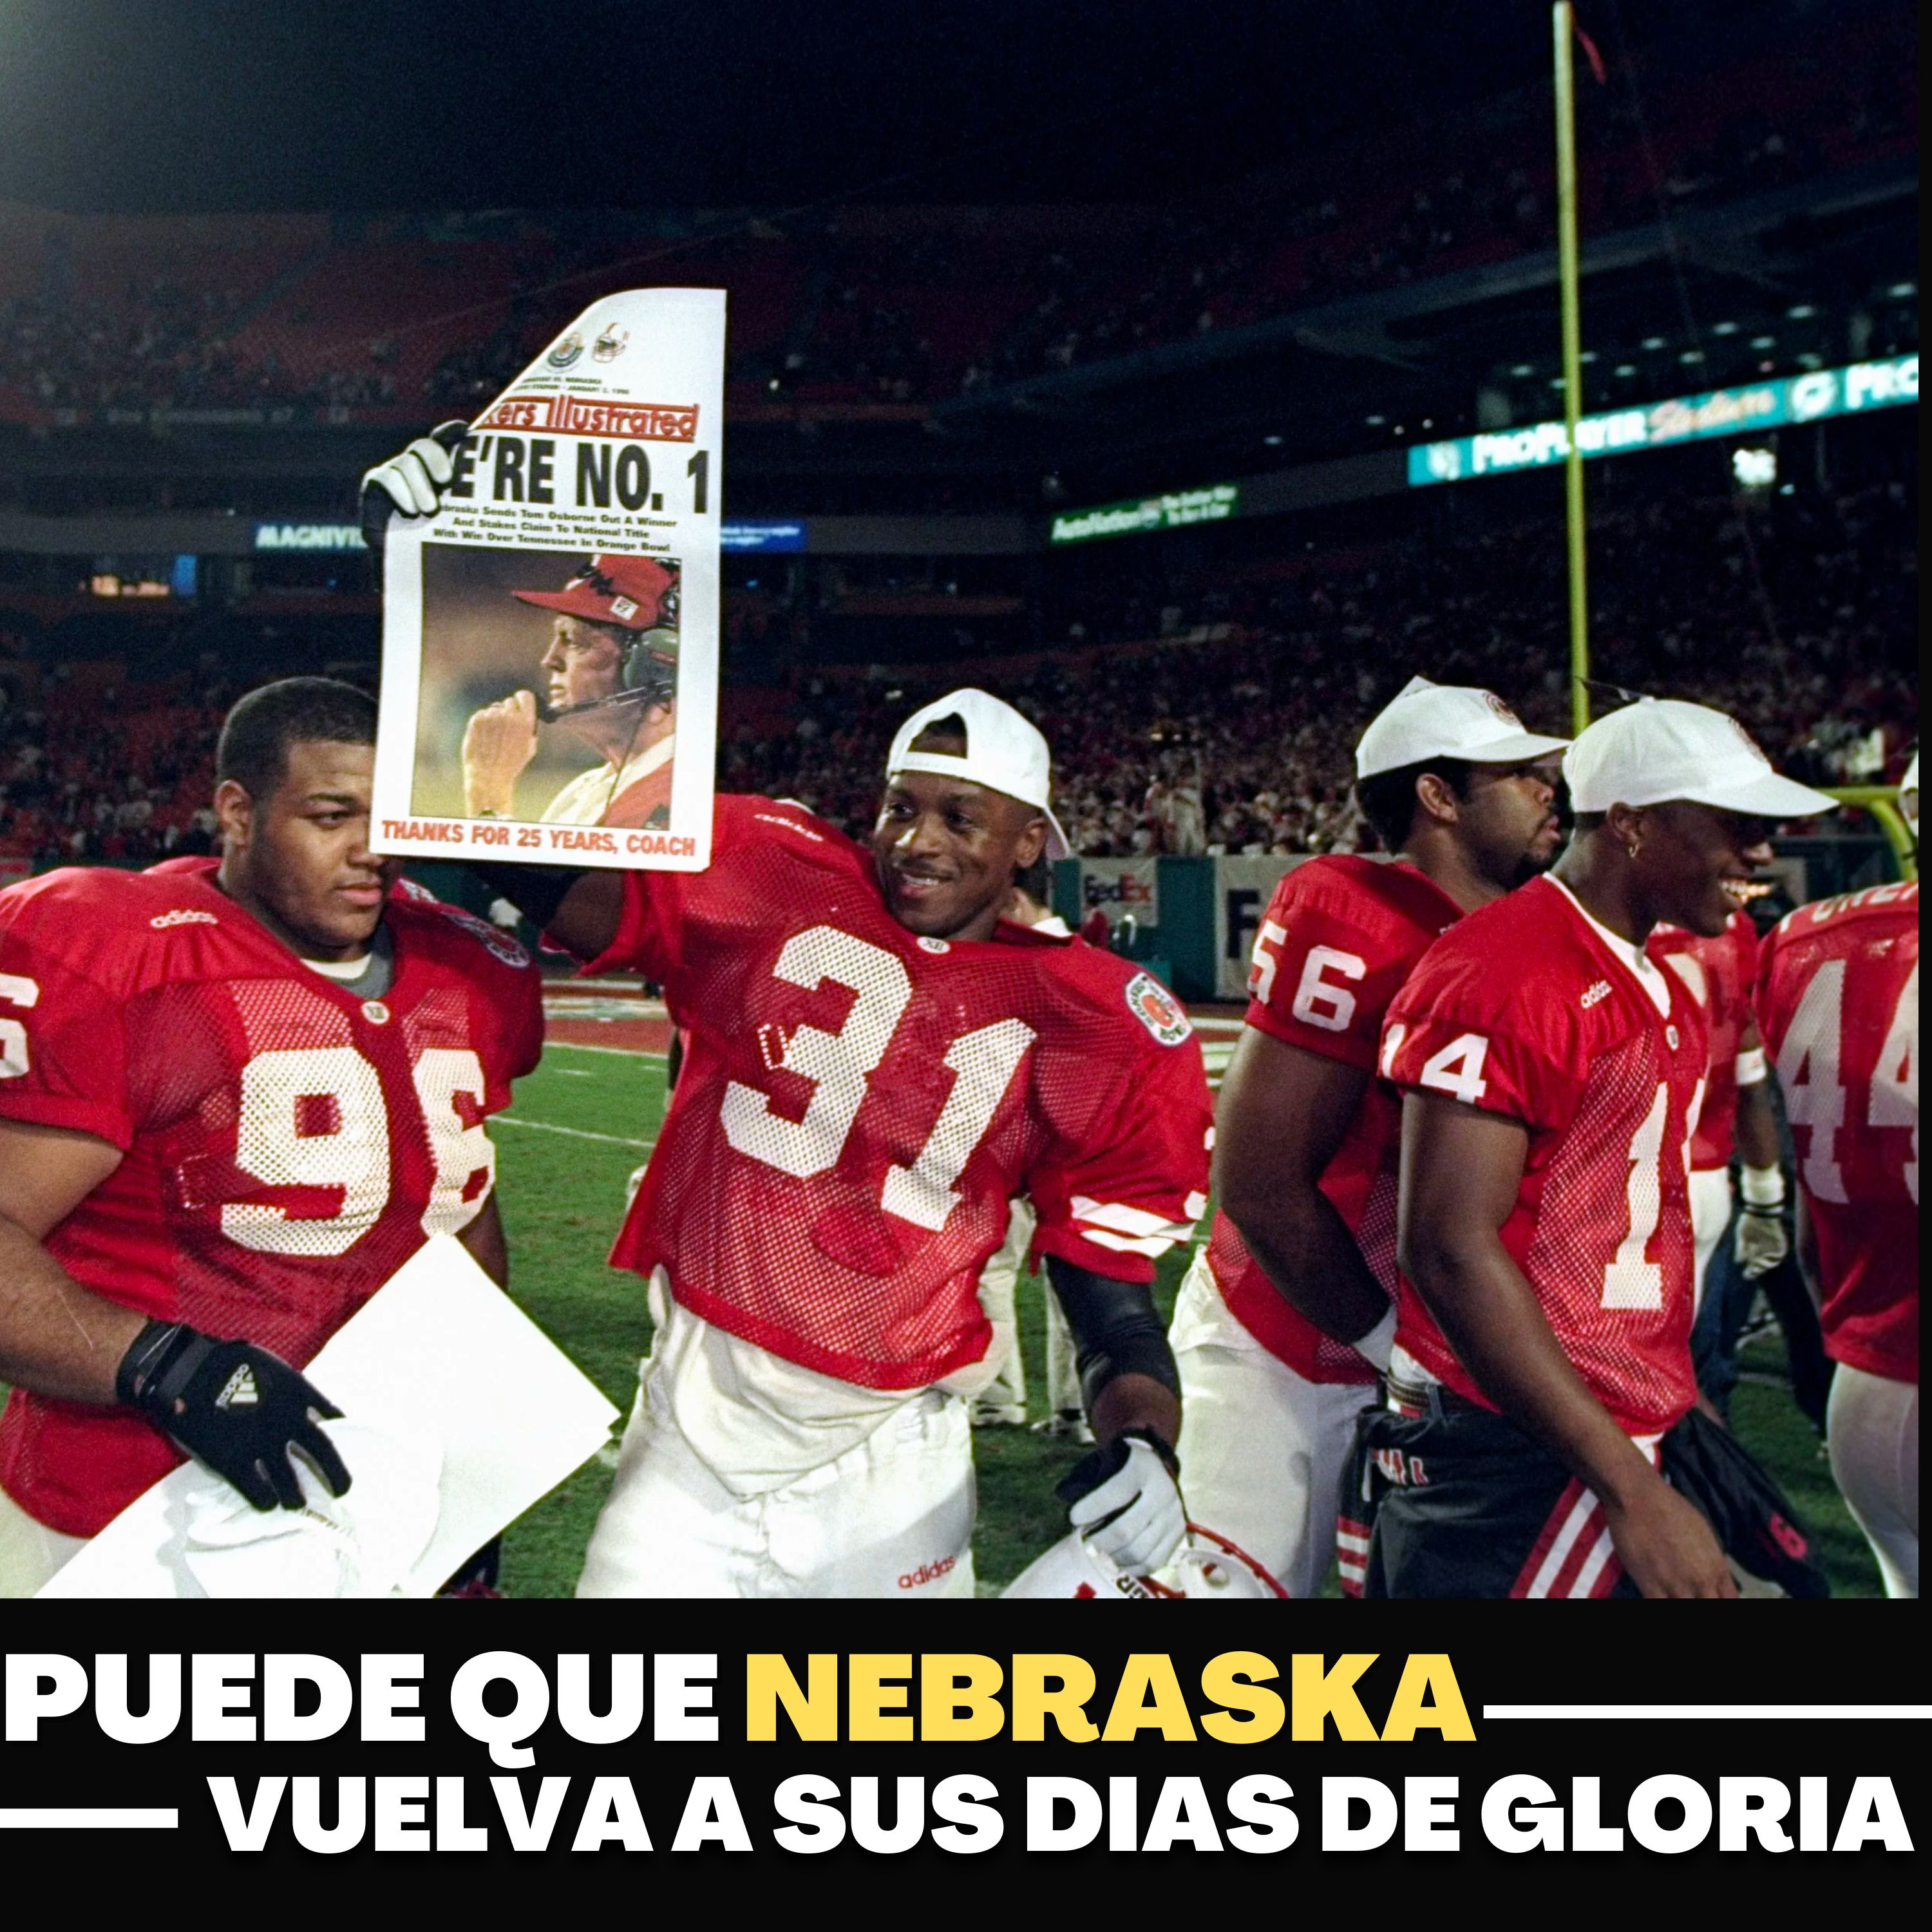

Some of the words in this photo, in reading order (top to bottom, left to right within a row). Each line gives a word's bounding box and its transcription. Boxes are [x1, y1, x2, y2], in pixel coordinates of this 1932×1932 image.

[546, 394, 699, 437] Illustrated
[576, 442, 664, 511] NO.
[687, 450, 709, 514] 1
[453, 517, 475, 526] And
[479, 519, 516, 529] Stakes
[521, 522, 553, 532] Claim
[556, 524, 569, 533] To
[574, 526, 621, 536] National
[625, 529, 649, 538] Title
[483, 506, 516, 516] Sends
[521, 509, 544, 518] Tom
[548, 511, 596, 522] Osborne
[600, 515, 621, 524] Out
[625, 516, 633, 525] A
[637, 517, 677, 527] Winner
[433, 528, 458, 538] With
[462, 531, 482, 540] Win
[487, 533, 513, 542] Over
[518, 534, 576, 545] Tennessee
[596, 539, 636, 551] Orange
[641, 542, 670, 552] Bowl
[382, 820, 464, 844] THANKS
[471, 825, 510, 846] FOR
[517, 828, 542, 848] 25
[549, 829, 618, 855] YEARS,
[626, 835, 696, 857] COACH
[150, 909, 218, 928] adidas
[1247, 920, 1367, 1031] 56
[1580, 978, 1613, 1009] adidas
[719, 925, 1037, 1232] 31
[1381, 1023, 1489, 1104] 14
[220, 1045, 496, 1256] 96
[1600, 1078, 1705, 1309] 1
[898, 1555, 957, 1589] adidas
